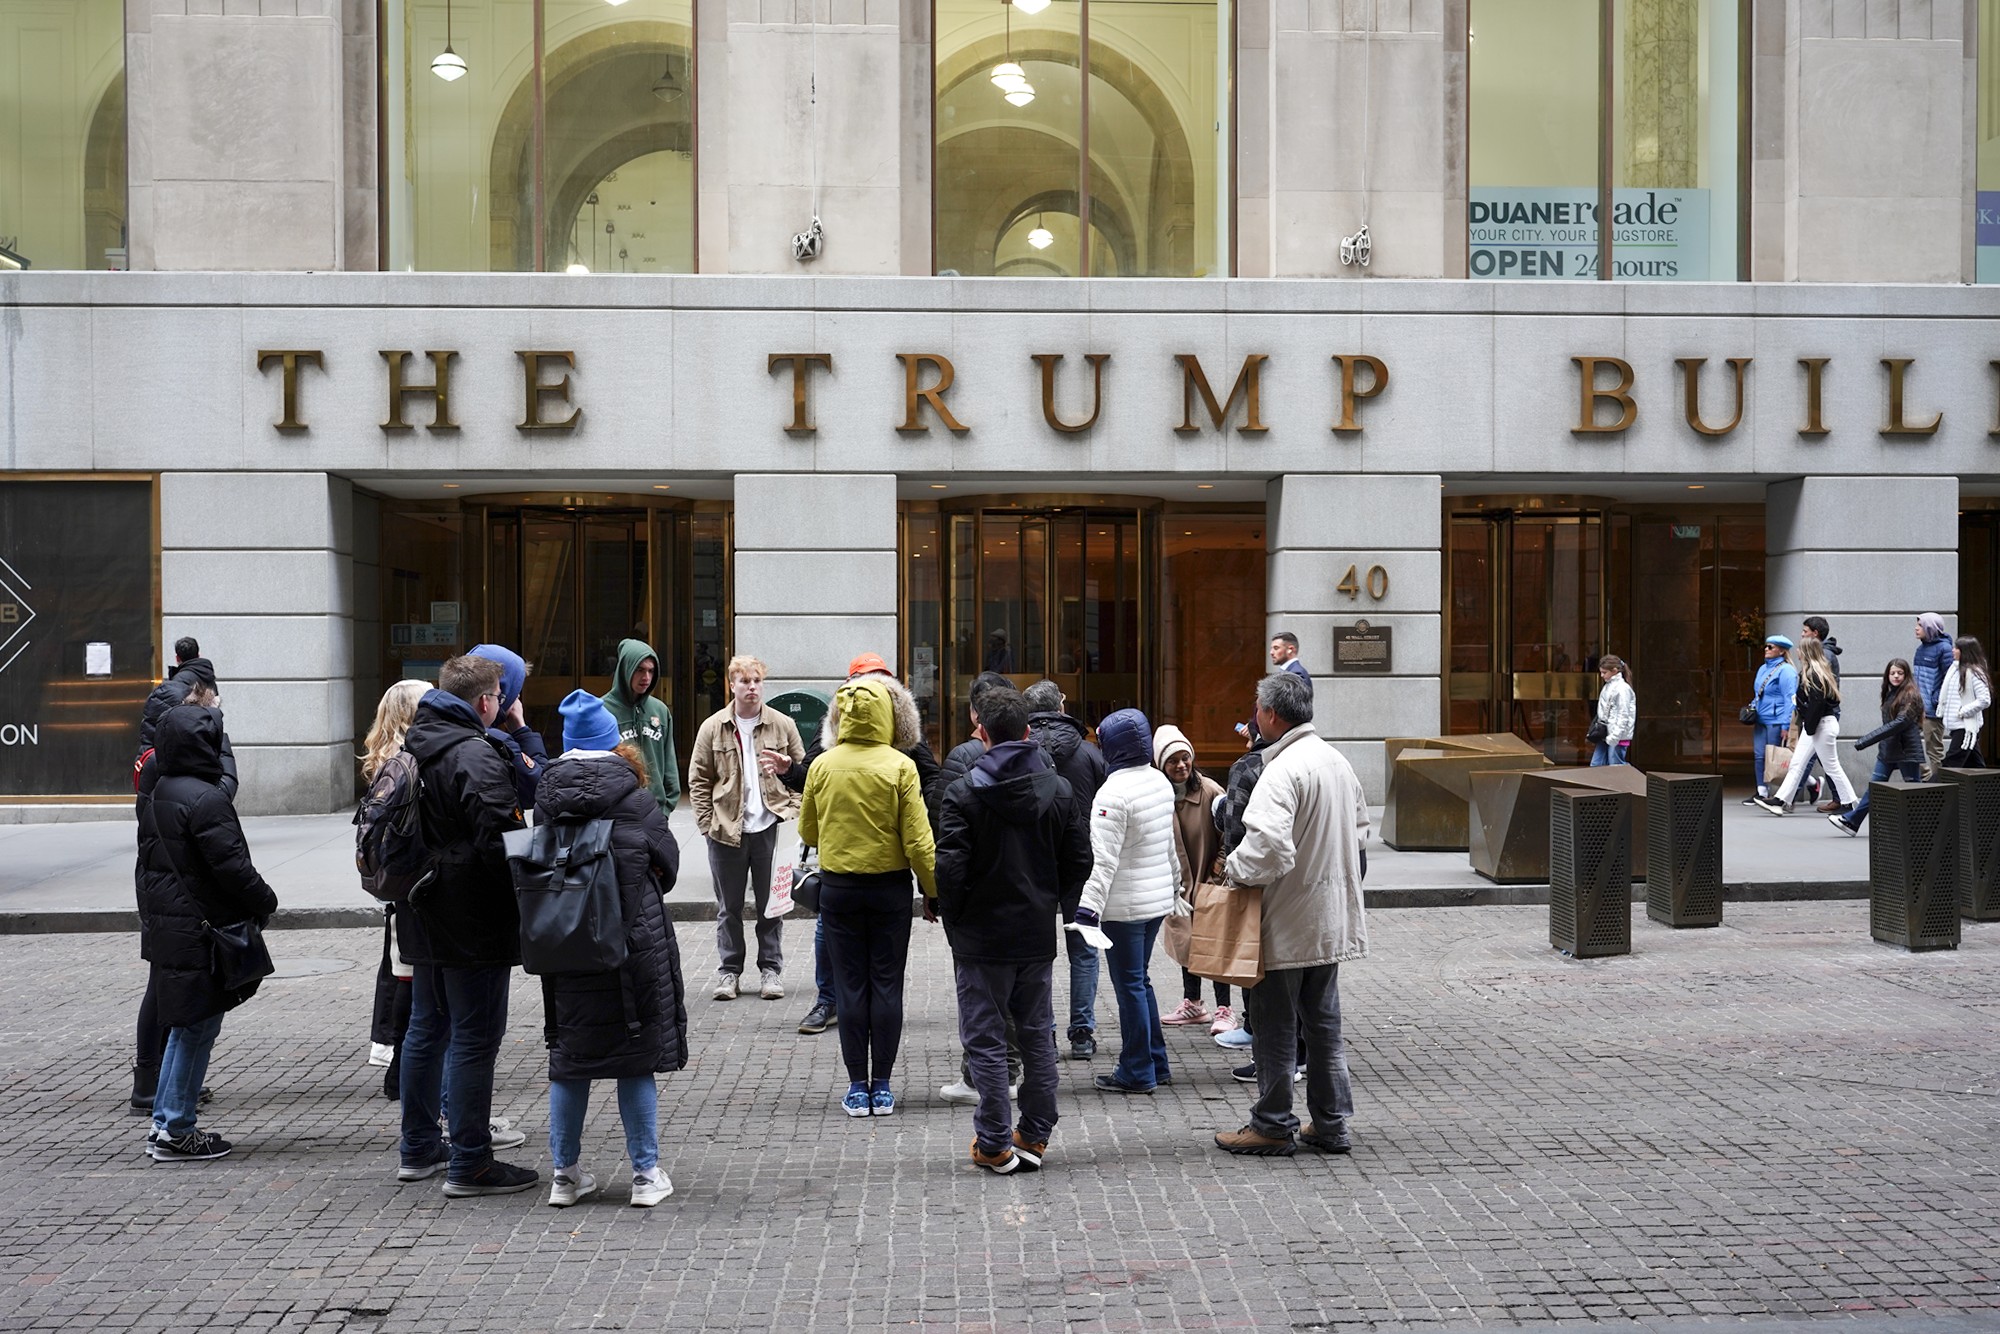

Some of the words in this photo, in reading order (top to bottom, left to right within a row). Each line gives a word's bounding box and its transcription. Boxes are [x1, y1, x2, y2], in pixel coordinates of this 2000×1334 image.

[1469, 202, 1570, 225] DUANE
[1470, 229, 1506, 241] YOUR
[1511, 229, 1544, 241] CITY.
[1550, 230, 1587, 241] YOUR
[1592, 230, 1678, 242] DUGSTORE.
[1470, 249, 1563, 276] OPEN
[257, 350, 582, 430] THE
[768, 353, 1389, 432] TRUMP
[1570, 356, 2000, 436] BUIL
[1336, 564, 1389, 600] 40
